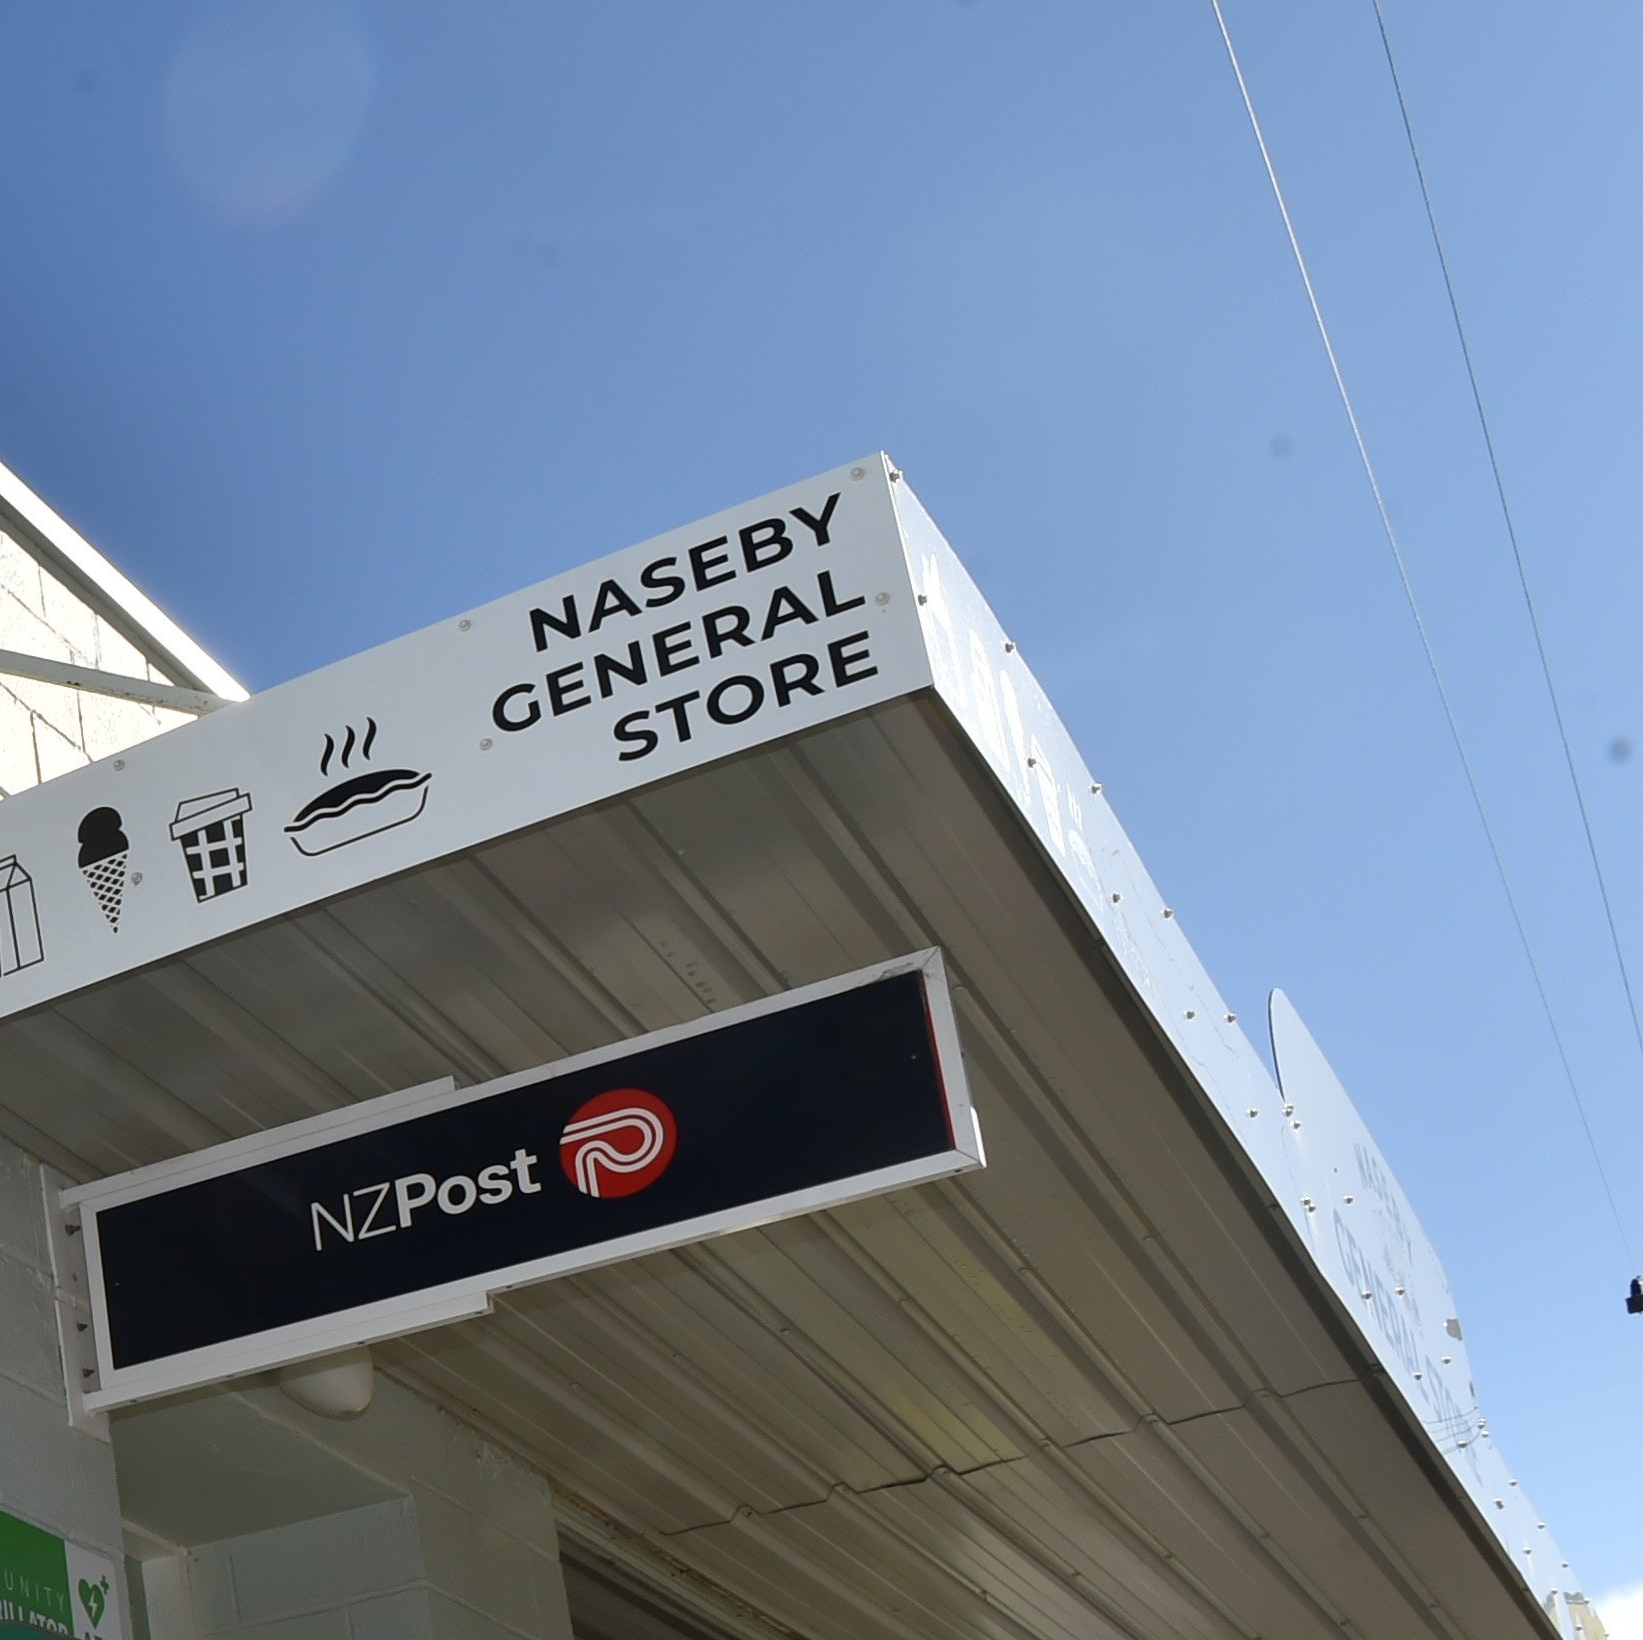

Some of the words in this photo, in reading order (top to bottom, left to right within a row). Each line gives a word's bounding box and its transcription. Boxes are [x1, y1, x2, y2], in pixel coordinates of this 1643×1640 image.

[528, 493, 841, 652] NASEBY
[492, 571, 866, 732] GENERAL
[614, 631, 878, 761] STORE
[311, 1149, 542, 1251] NZPost
